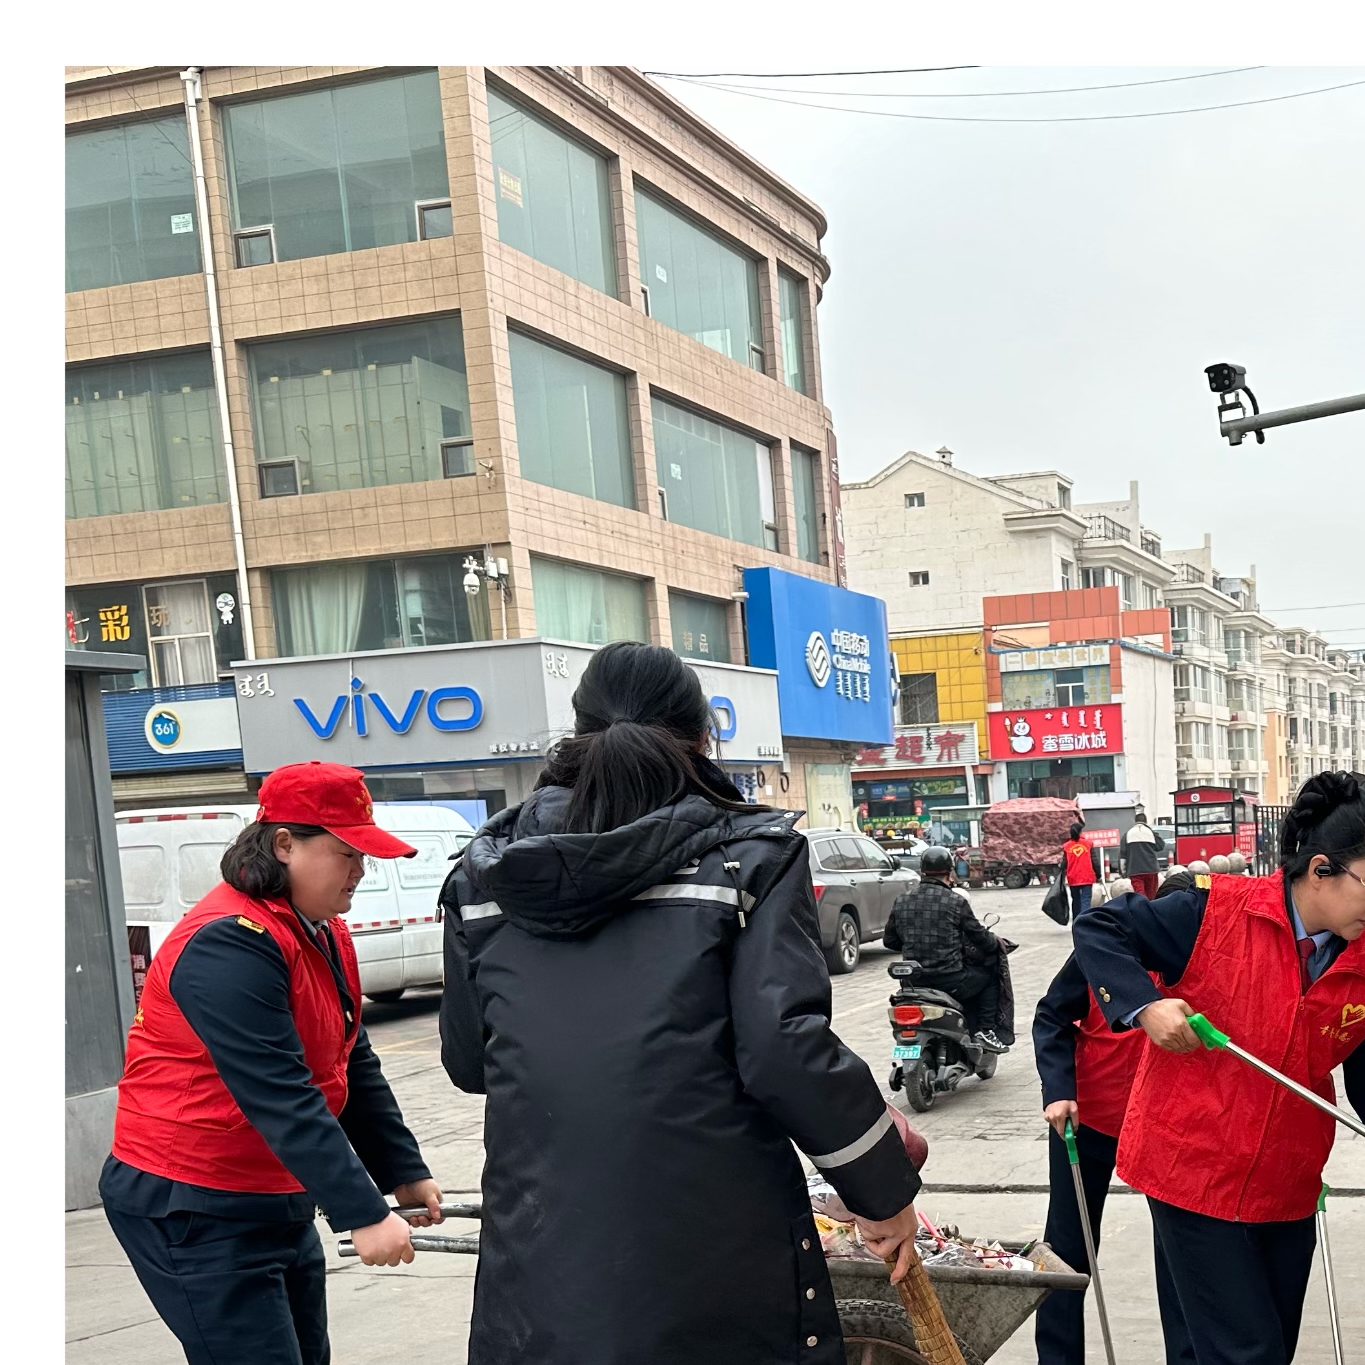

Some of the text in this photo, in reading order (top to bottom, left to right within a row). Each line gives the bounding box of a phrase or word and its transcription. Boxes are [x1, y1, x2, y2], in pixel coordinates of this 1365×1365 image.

[831, 628, 870, 657] 中国移动
[293, 676, 485, 740] vivo
[1042, 730, 1108, 753] 蜜雪冰城
